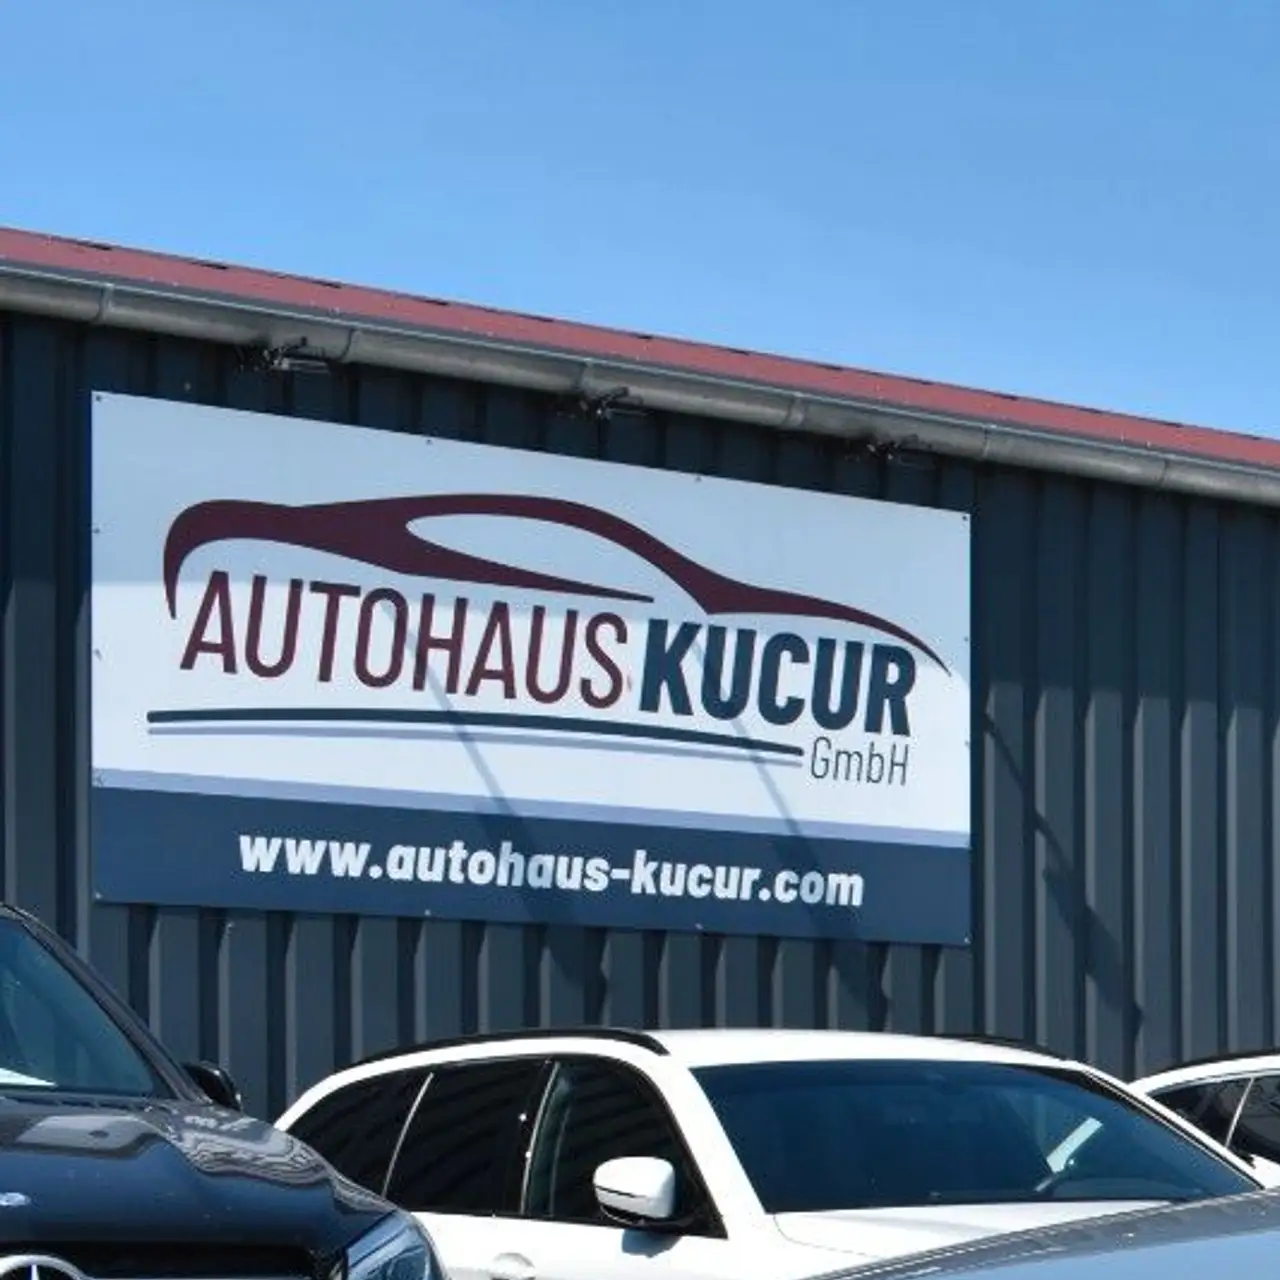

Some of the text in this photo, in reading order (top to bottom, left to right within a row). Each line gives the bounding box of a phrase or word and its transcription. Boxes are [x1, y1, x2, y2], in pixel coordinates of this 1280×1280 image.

[179, 569, 917, 737] AUTOHAUS KUCUR
[810, 736, 909, 787] GmbH
[239, 834, 865, 907] www.autohaus-kucur.com
